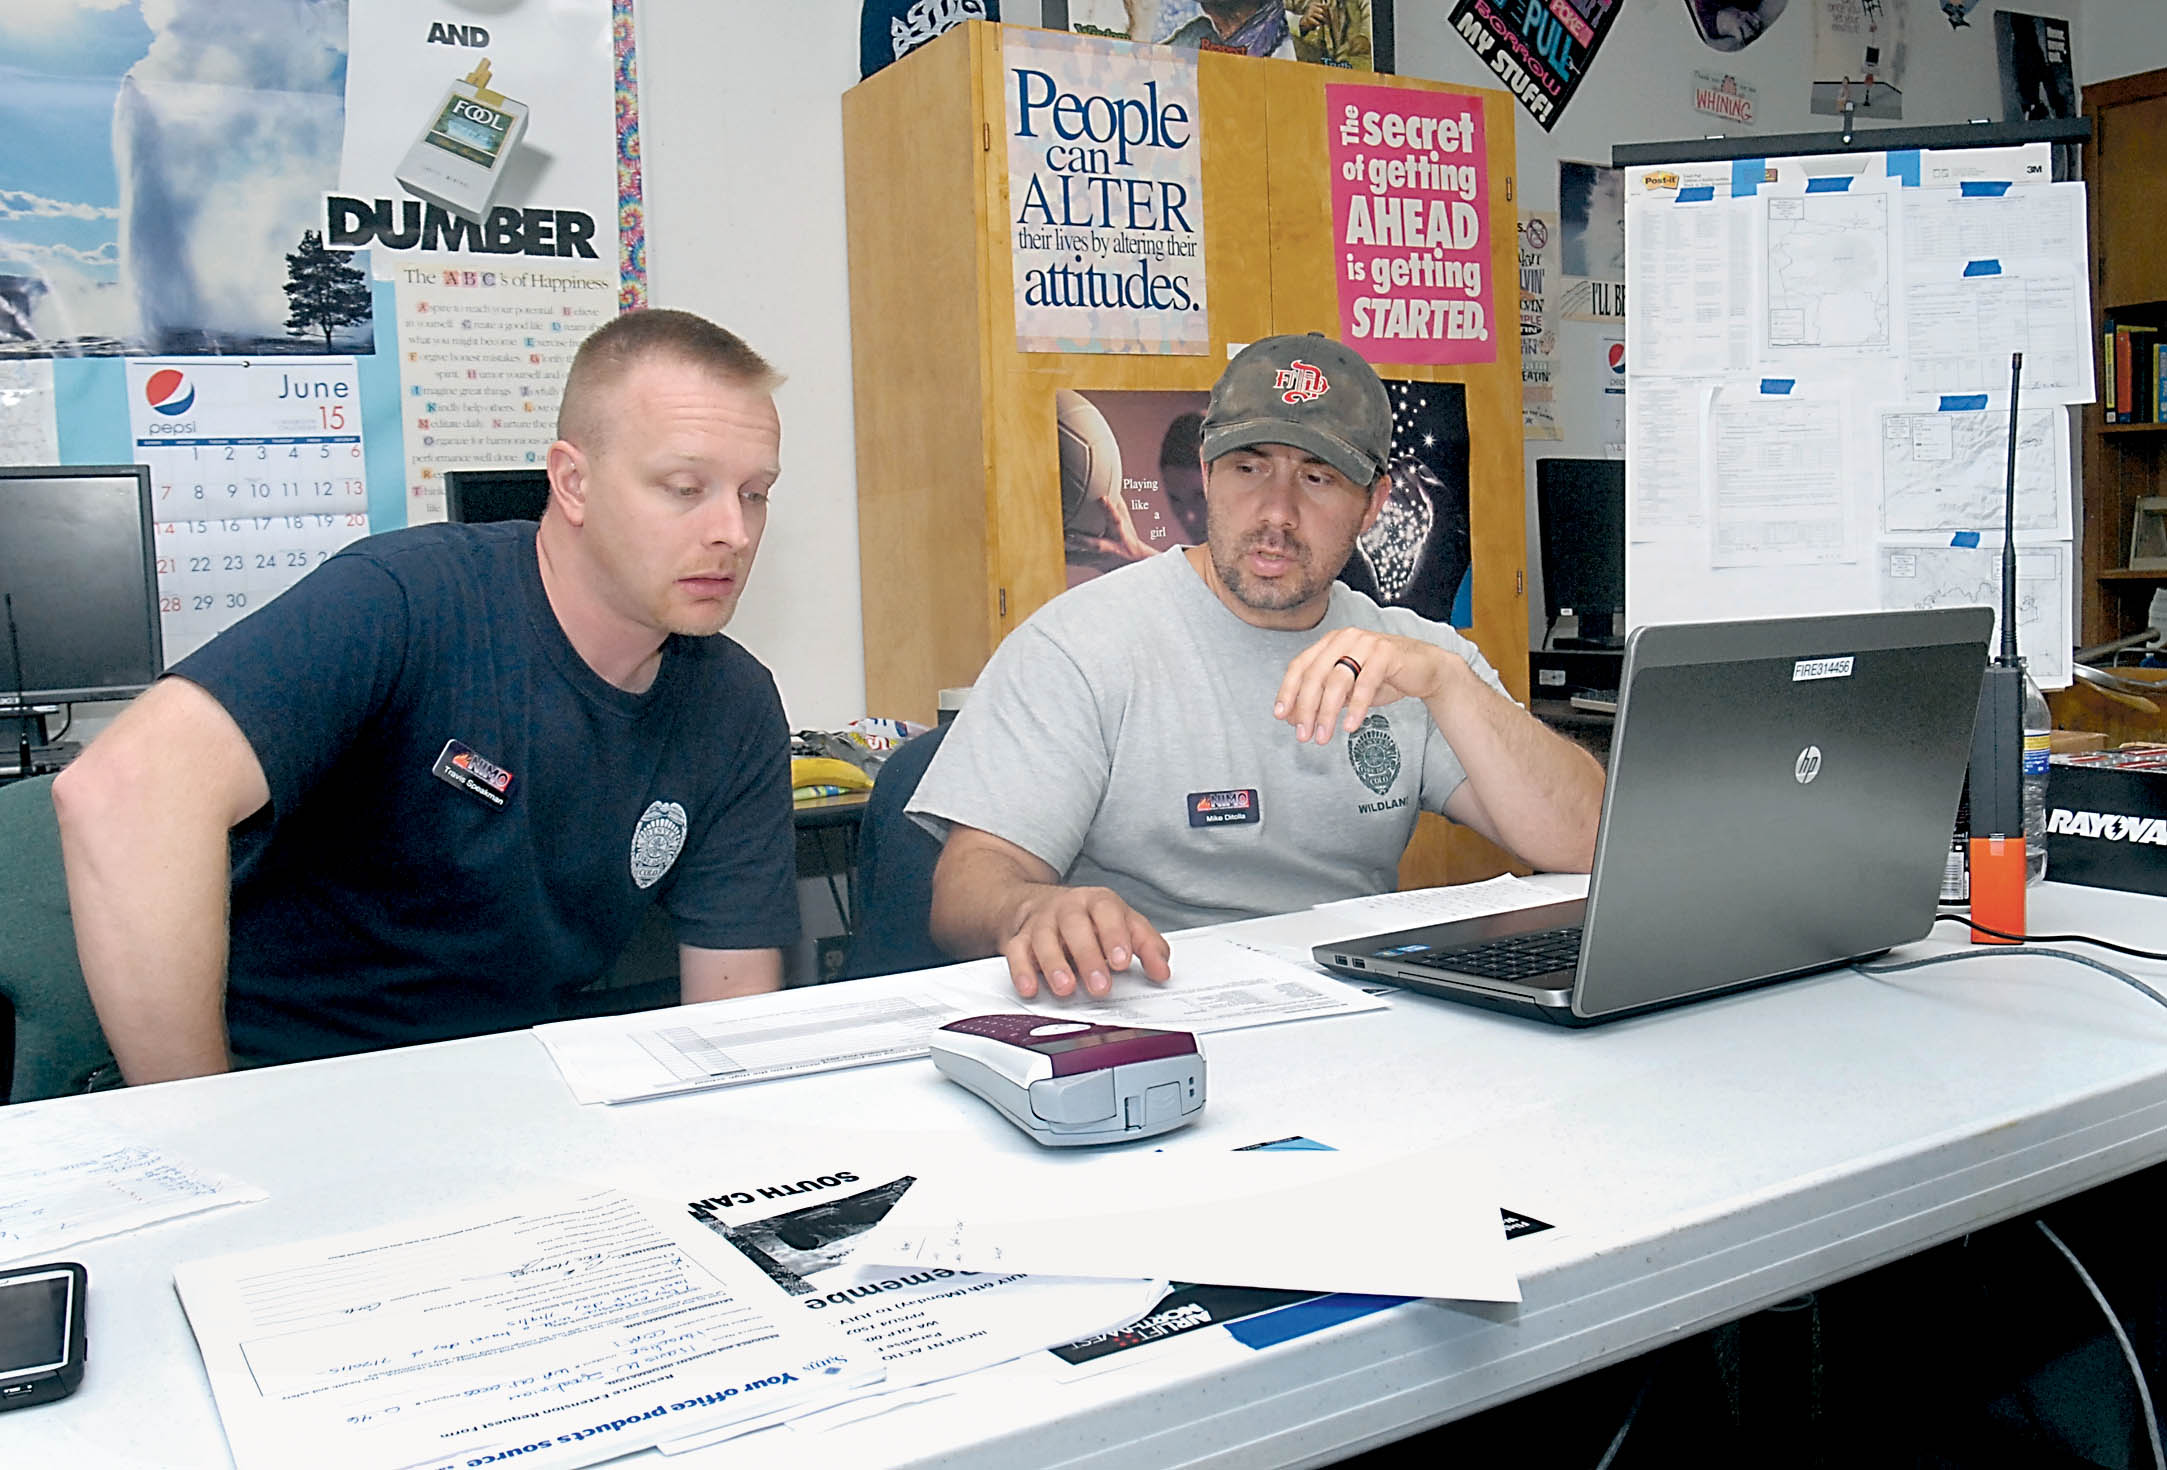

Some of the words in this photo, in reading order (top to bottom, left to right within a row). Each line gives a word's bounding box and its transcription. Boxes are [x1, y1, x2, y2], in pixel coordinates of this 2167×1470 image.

[426, 22, 490, 48] AND
[1522, 0, 1572, 82] PULL
[1474, 0, 1561, 96] BORROW
[1456, 12, 1495, 55] MY
[1490, 49, 1554, 123] STUFF!
[453, 100, 503, 131] FOOL
[1010, 68, 1191, 165] People
[1696, 88, 1752, 120] WHINING
[1341, 105, 1359, 146] The
[1362, 111, 1474, 153] secret
[1046, 142, 1111, 176] can
[2026, 164, 2043, 174] 3M
[1343, 155, 1365, 182] of
[1369, 147, 1478, 200] getting
[1645, 177, 1675, 185] Post-it
[1017, 174, 1193, 233] ALTER
[326, 195, 600, 259] DUMBER
[1346, 195, 1479, 251] AHEAD
[1019, 228, 1051, 251] their
[1055, 228, 1087, 254] lives
[1092, 231, 1110, 258] by
[1112, 233, 1164, 260] altering
[1166, 235, 1197, 258] their
[404, 268, 437, 285] The
[511, 274, 527, 288] of
[531, 274, 609, 292] Happiness
[1024, 254, 1200, 312] attitudes.
[1347, 254, 1366, 279] is
[1371, 247, 1481, 298] getting
[1591, 283, 1611, 316] I'LL
[1352, 298, 1489, 341] STARTED.
[278, 374, 349, 399] June
[149, 420, 197, 436] pepsi
[318, 405, 345, 431] 15
[193, 447, 198, 460] 1
[225, 447, 235, 461] 2
[257, 446, 267, 460] 3
[288, 446, 299, 459] 4
[320, 446, 330, 459] 5
[351, 446, 361, 458] 6
[161, 486, 171, 500] 7
[194, 485, 204, 500] 8
[227, 484, 237, 498] 9
[251, 483, 270, 498] 10
[283, 482, 299, 497] 11
[314, 482, 333, 496] 12
[344, 481, 363, 495] 13
[1123, 477, 1159, 492] Playing
[1131, 498, 1149, 512] like
[1154, 512, 1160, 520] a
[155, 522, 175, 535] 14
[187, 522, 207, 534] 15
[220, 520, 240, 532] 16
[253, 519, 271, 531] 17
[284, 517, 304, 530] 18
[315, 515, 334, 528] 19
[346, 514, 365, 527] 20
[1150, 526, 1167, 540] girl
[158, 559, 176, 574] 21
[190, 557, 211, 572] 22
[224, 556, 243, 571] 23
[255, 554, 276, 569] 24
[287, 553, 307, 568] 25
[161, 598, 182, 612] 28
[193, 595, 214, 610] 29
[226, 593, 246, 608] 30
[1795, 660, 1850, 678] FIRE314456
[468, 754, 508, 786] NIMO
[1799, 751, 1818, 778] hp
[444, 765, 467, 784] Travis
[466, 779, 504, 805] Speakman
[1210, 792, 1247, 808] NIMO
[756, 1172, 859, 1199] SOUTH
[895, 1290, 966, 1308] (Monday)
[968, 1283, 993, 1291] 6th
[847, 1325, 874, 1335] 1502
[1138, 1311, 1211, 1340] AIRLIFT
[890, 1332, 942, 1347] Paradise
[928, 1331, 987, 1349] INCIDENT
[613, 1374, 673, 1394] Resource
[745, 1373, 798, 1391] Your
[543, 1394, 609, 1413] Extension
[671, 1389, 738, 1410] office
[441, 1427, 477, 1437] Form
[483, 1413, 539, 1428] Request
[557, 1406, 667, 1443] products
[467, 1440, 552, 1466] source
